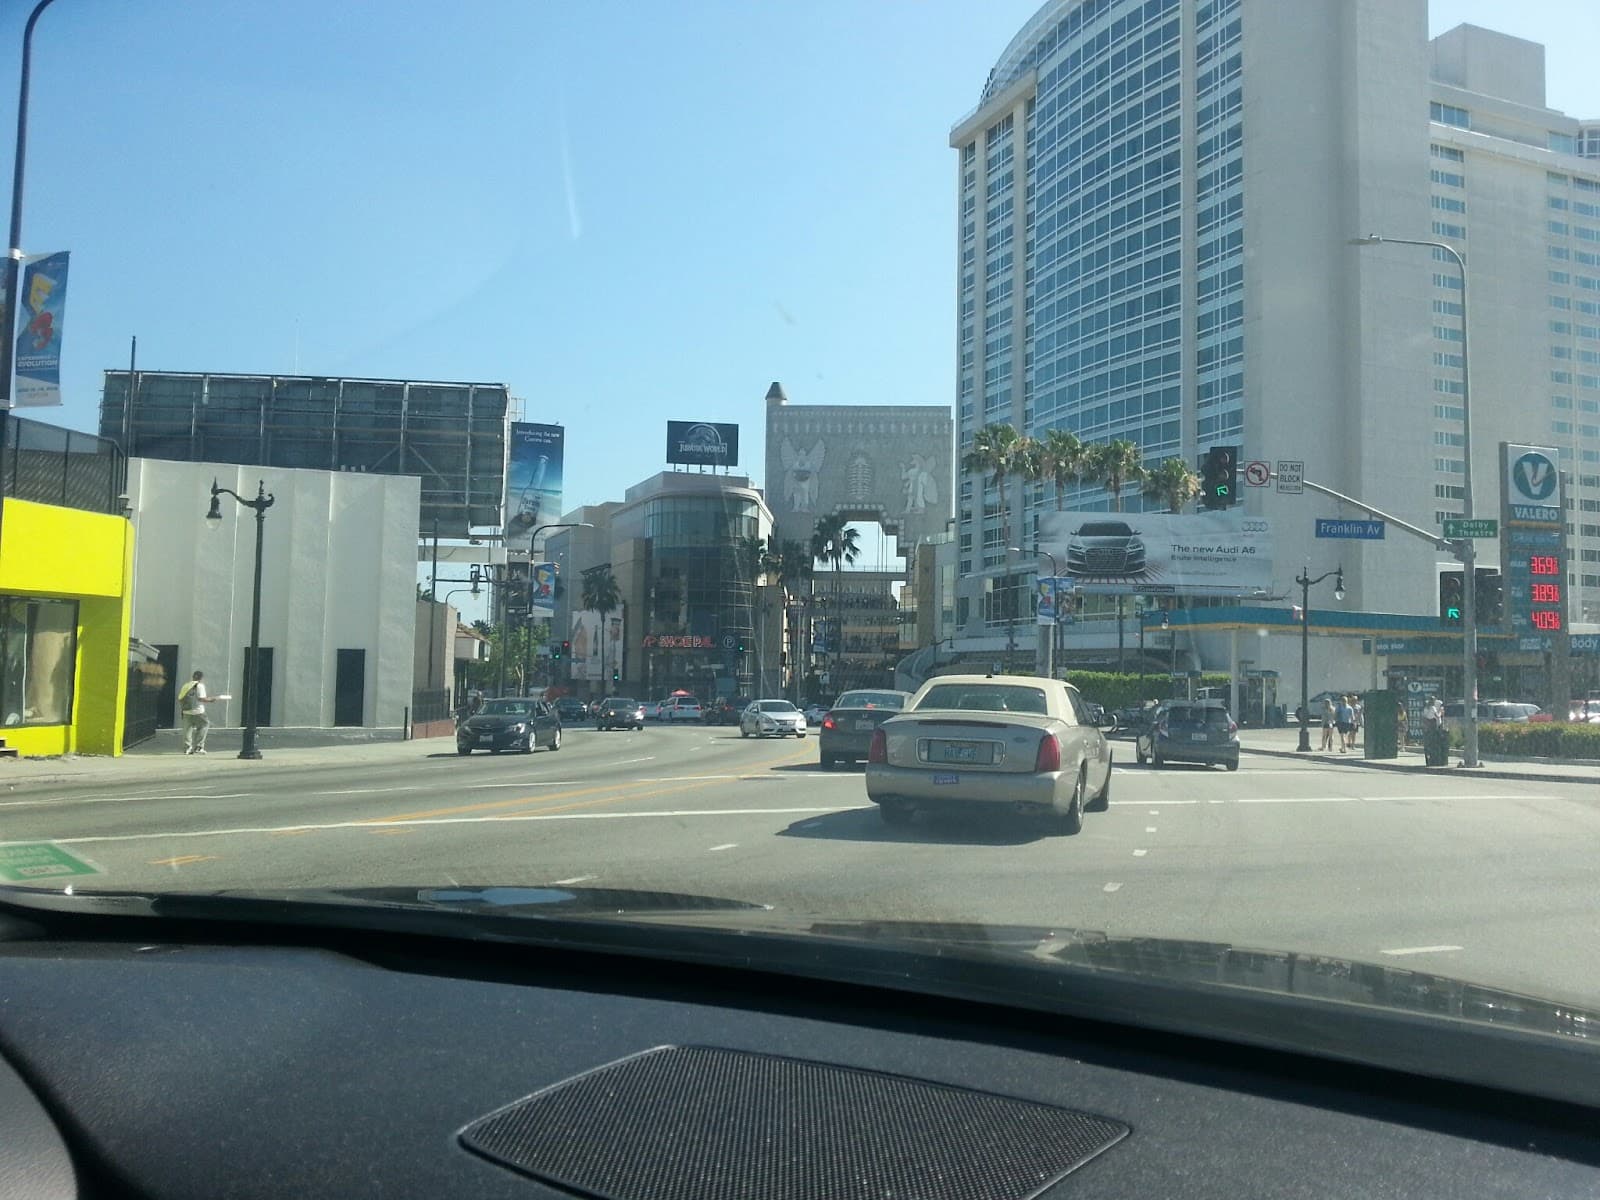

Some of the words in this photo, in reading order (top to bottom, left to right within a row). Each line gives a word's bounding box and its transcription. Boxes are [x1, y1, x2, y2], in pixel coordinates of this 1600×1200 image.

[1280, 463, 1288, 472] DO
[1290, 464, 1301, 473] NOT
[1280, 474, 1301, 483] BLOCK
[1514, 507, 1557, 521] VALERO
[1321, 523, 1362, 534] Franklin
[1367, 525, 1380, 535] Av
[1459, 529, 1494, 537] Theatre
[1171, 545, 1190, 553] The
[1216, 545, 1239, 554] Audi
[1241, 546, 1256, 554] A6
[1571, 637, 1598, 652] Body
